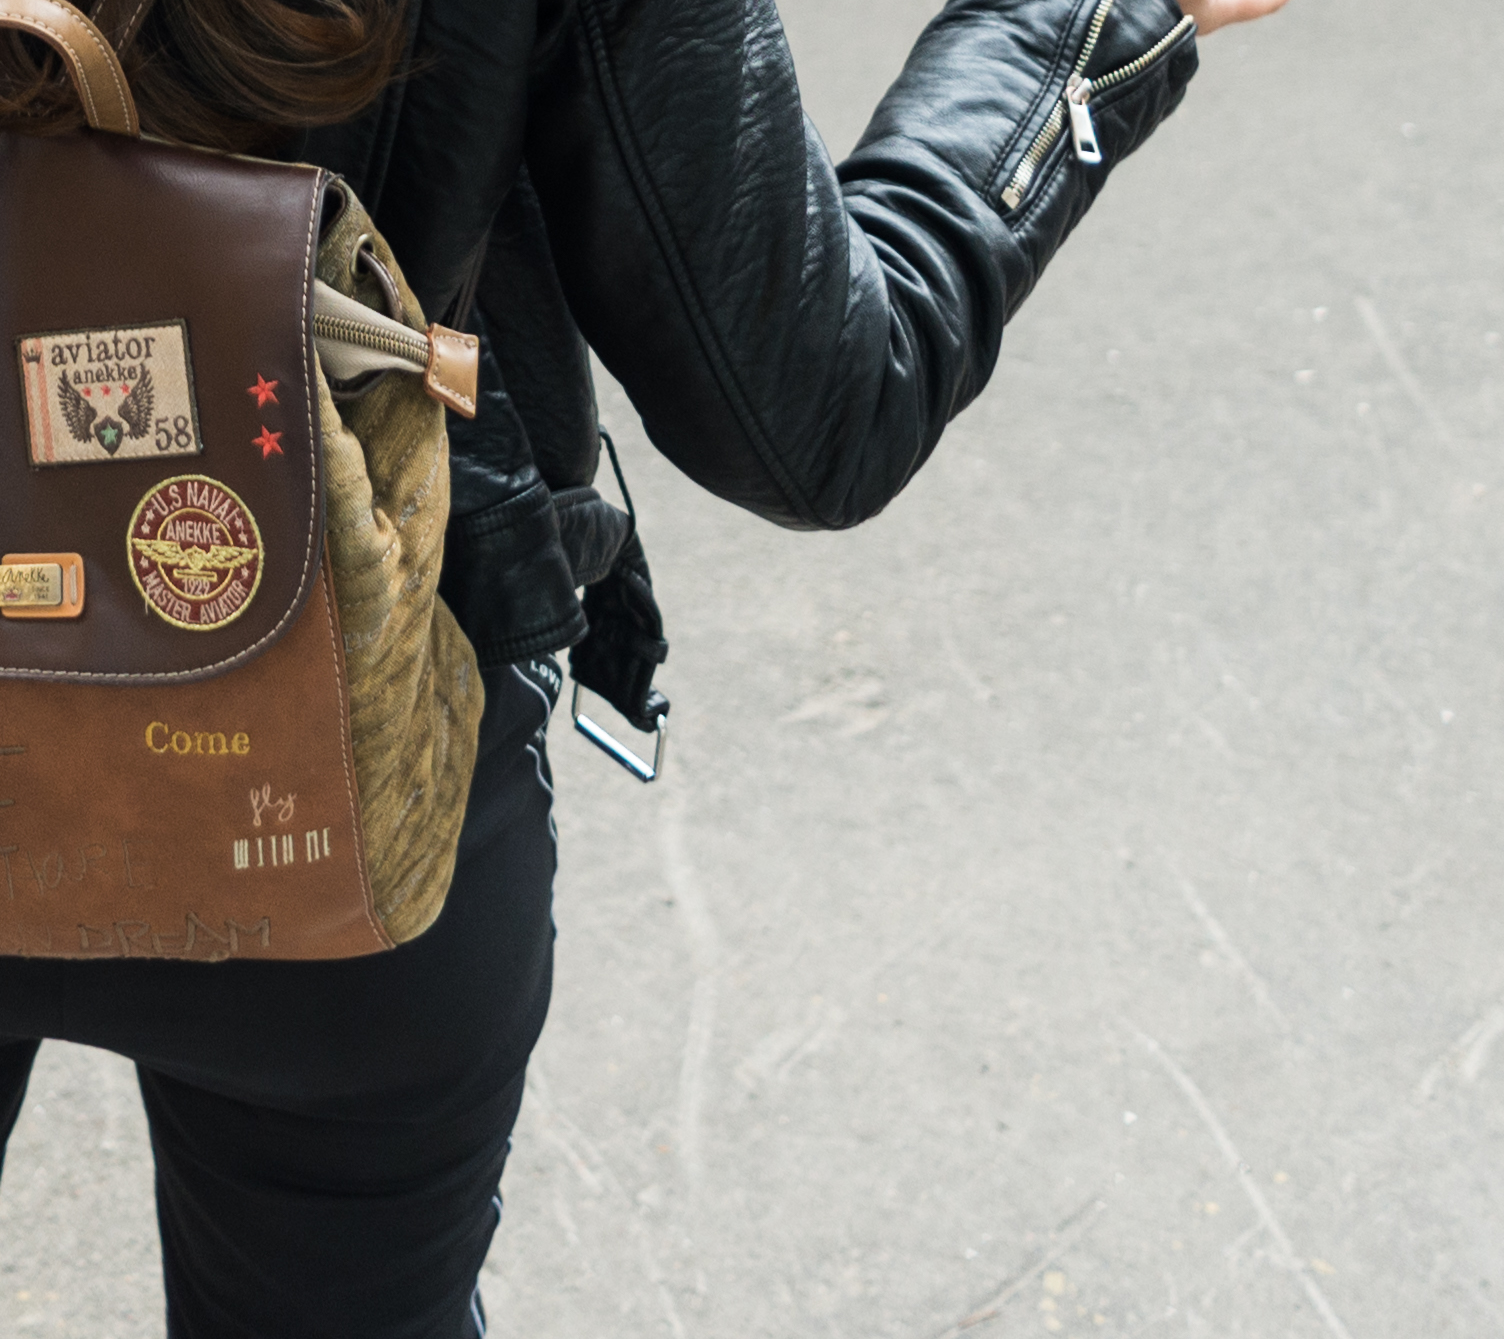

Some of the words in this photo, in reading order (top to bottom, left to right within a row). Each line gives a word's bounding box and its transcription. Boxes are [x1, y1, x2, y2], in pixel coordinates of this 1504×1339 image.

[50, 332, 156, 366] aviator
[72, 363, 139, 385] anekke
[154, 414, 192, 451] 58
[187, 481, 240, 529] NAVAL
[165, 520, 222, 545] ANEKKE
[142, 570, 192, 623] MASTER
[199, 579, 249, 624] AVIATOR
[144, 721, 251, 755] Come
[249, 781, 298, 826] fly
